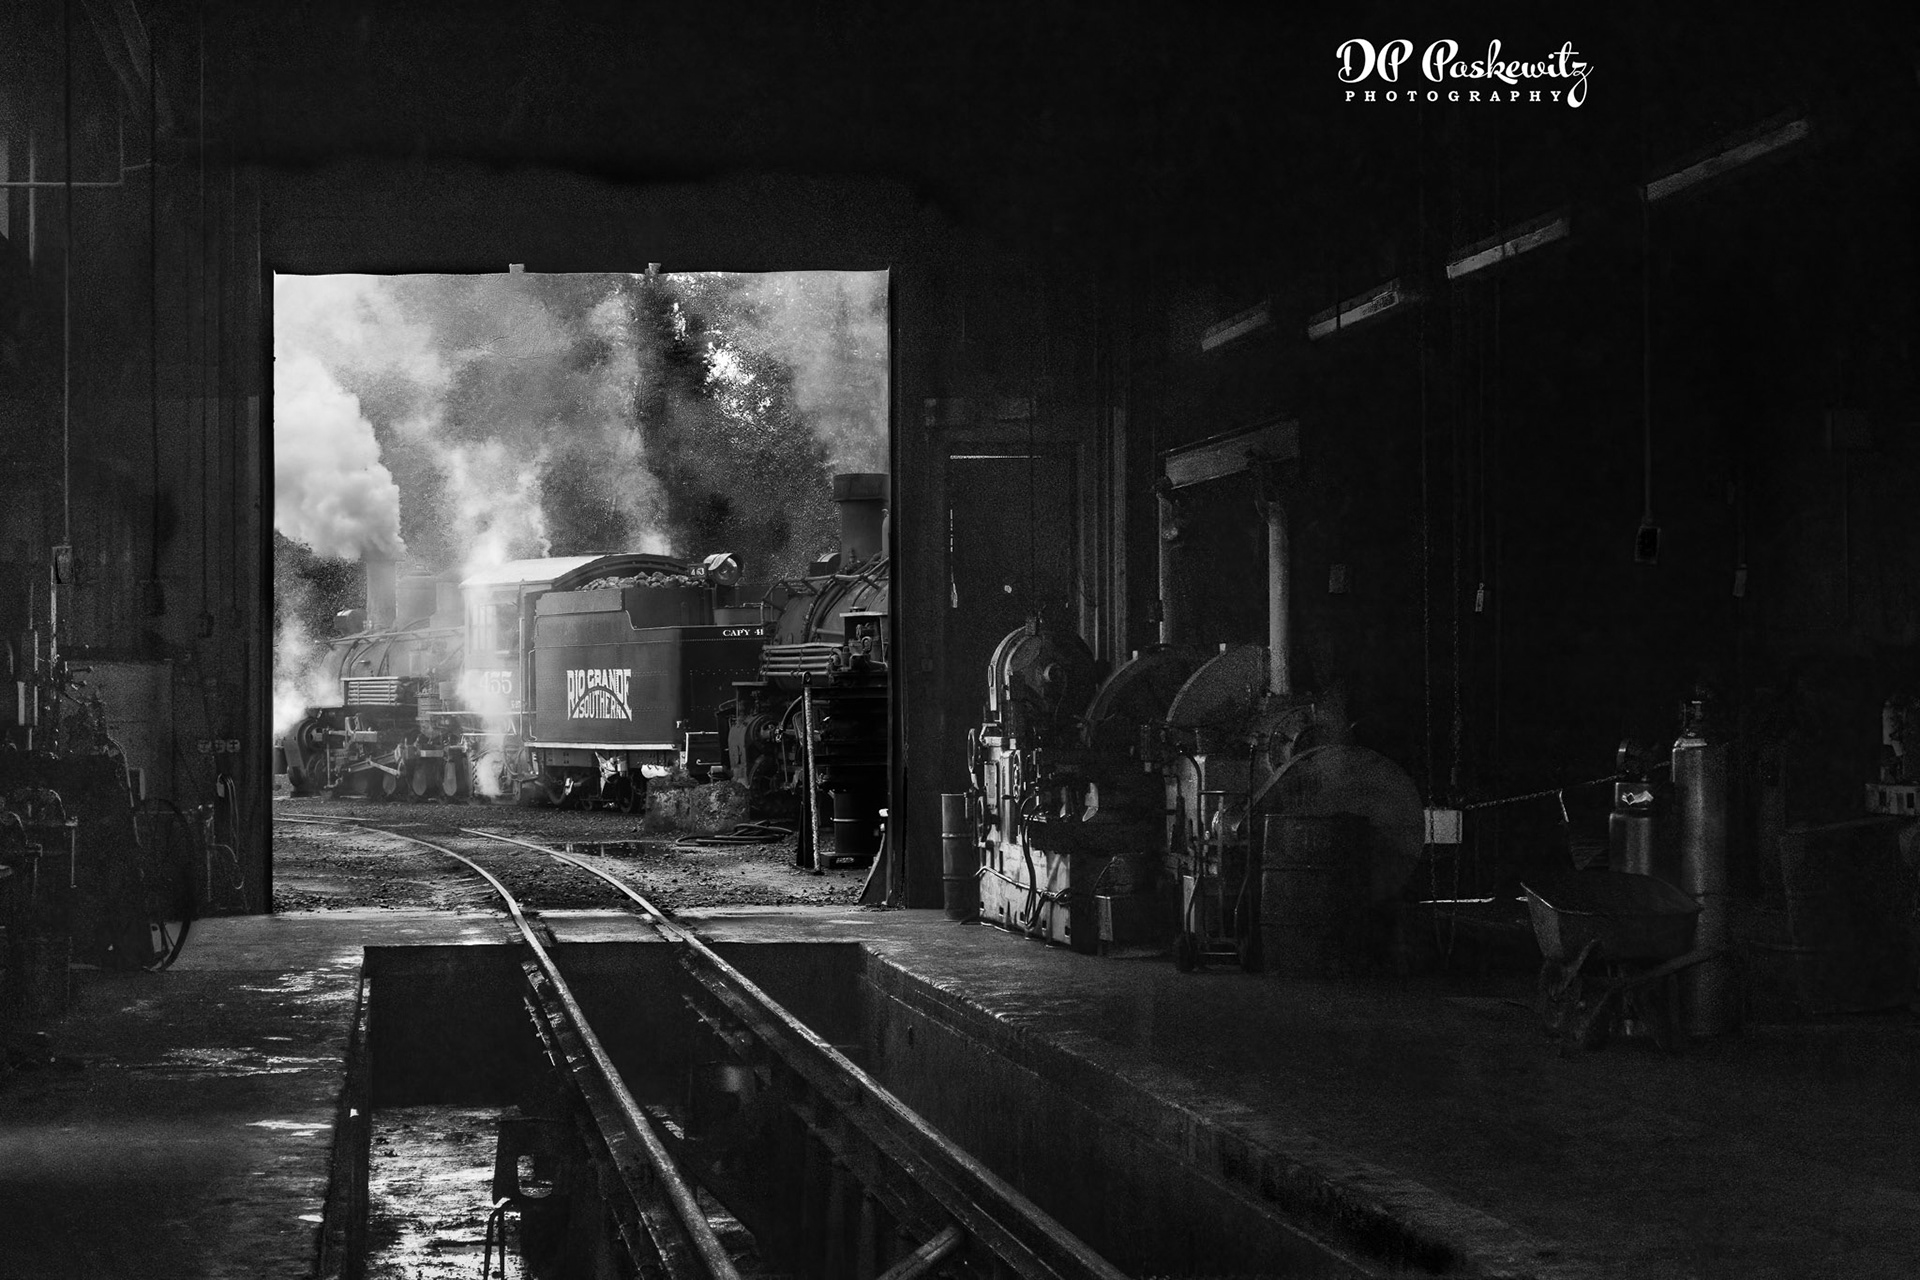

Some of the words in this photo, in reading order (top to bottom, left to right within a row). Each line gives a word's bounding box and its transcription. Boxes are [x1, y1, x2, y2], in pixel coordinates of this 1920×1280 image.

[566, 669, 586, 721] RIO
[587, 668, 632, 722] GRANDE
[579, 689, 627, 719] SOUTHERN
